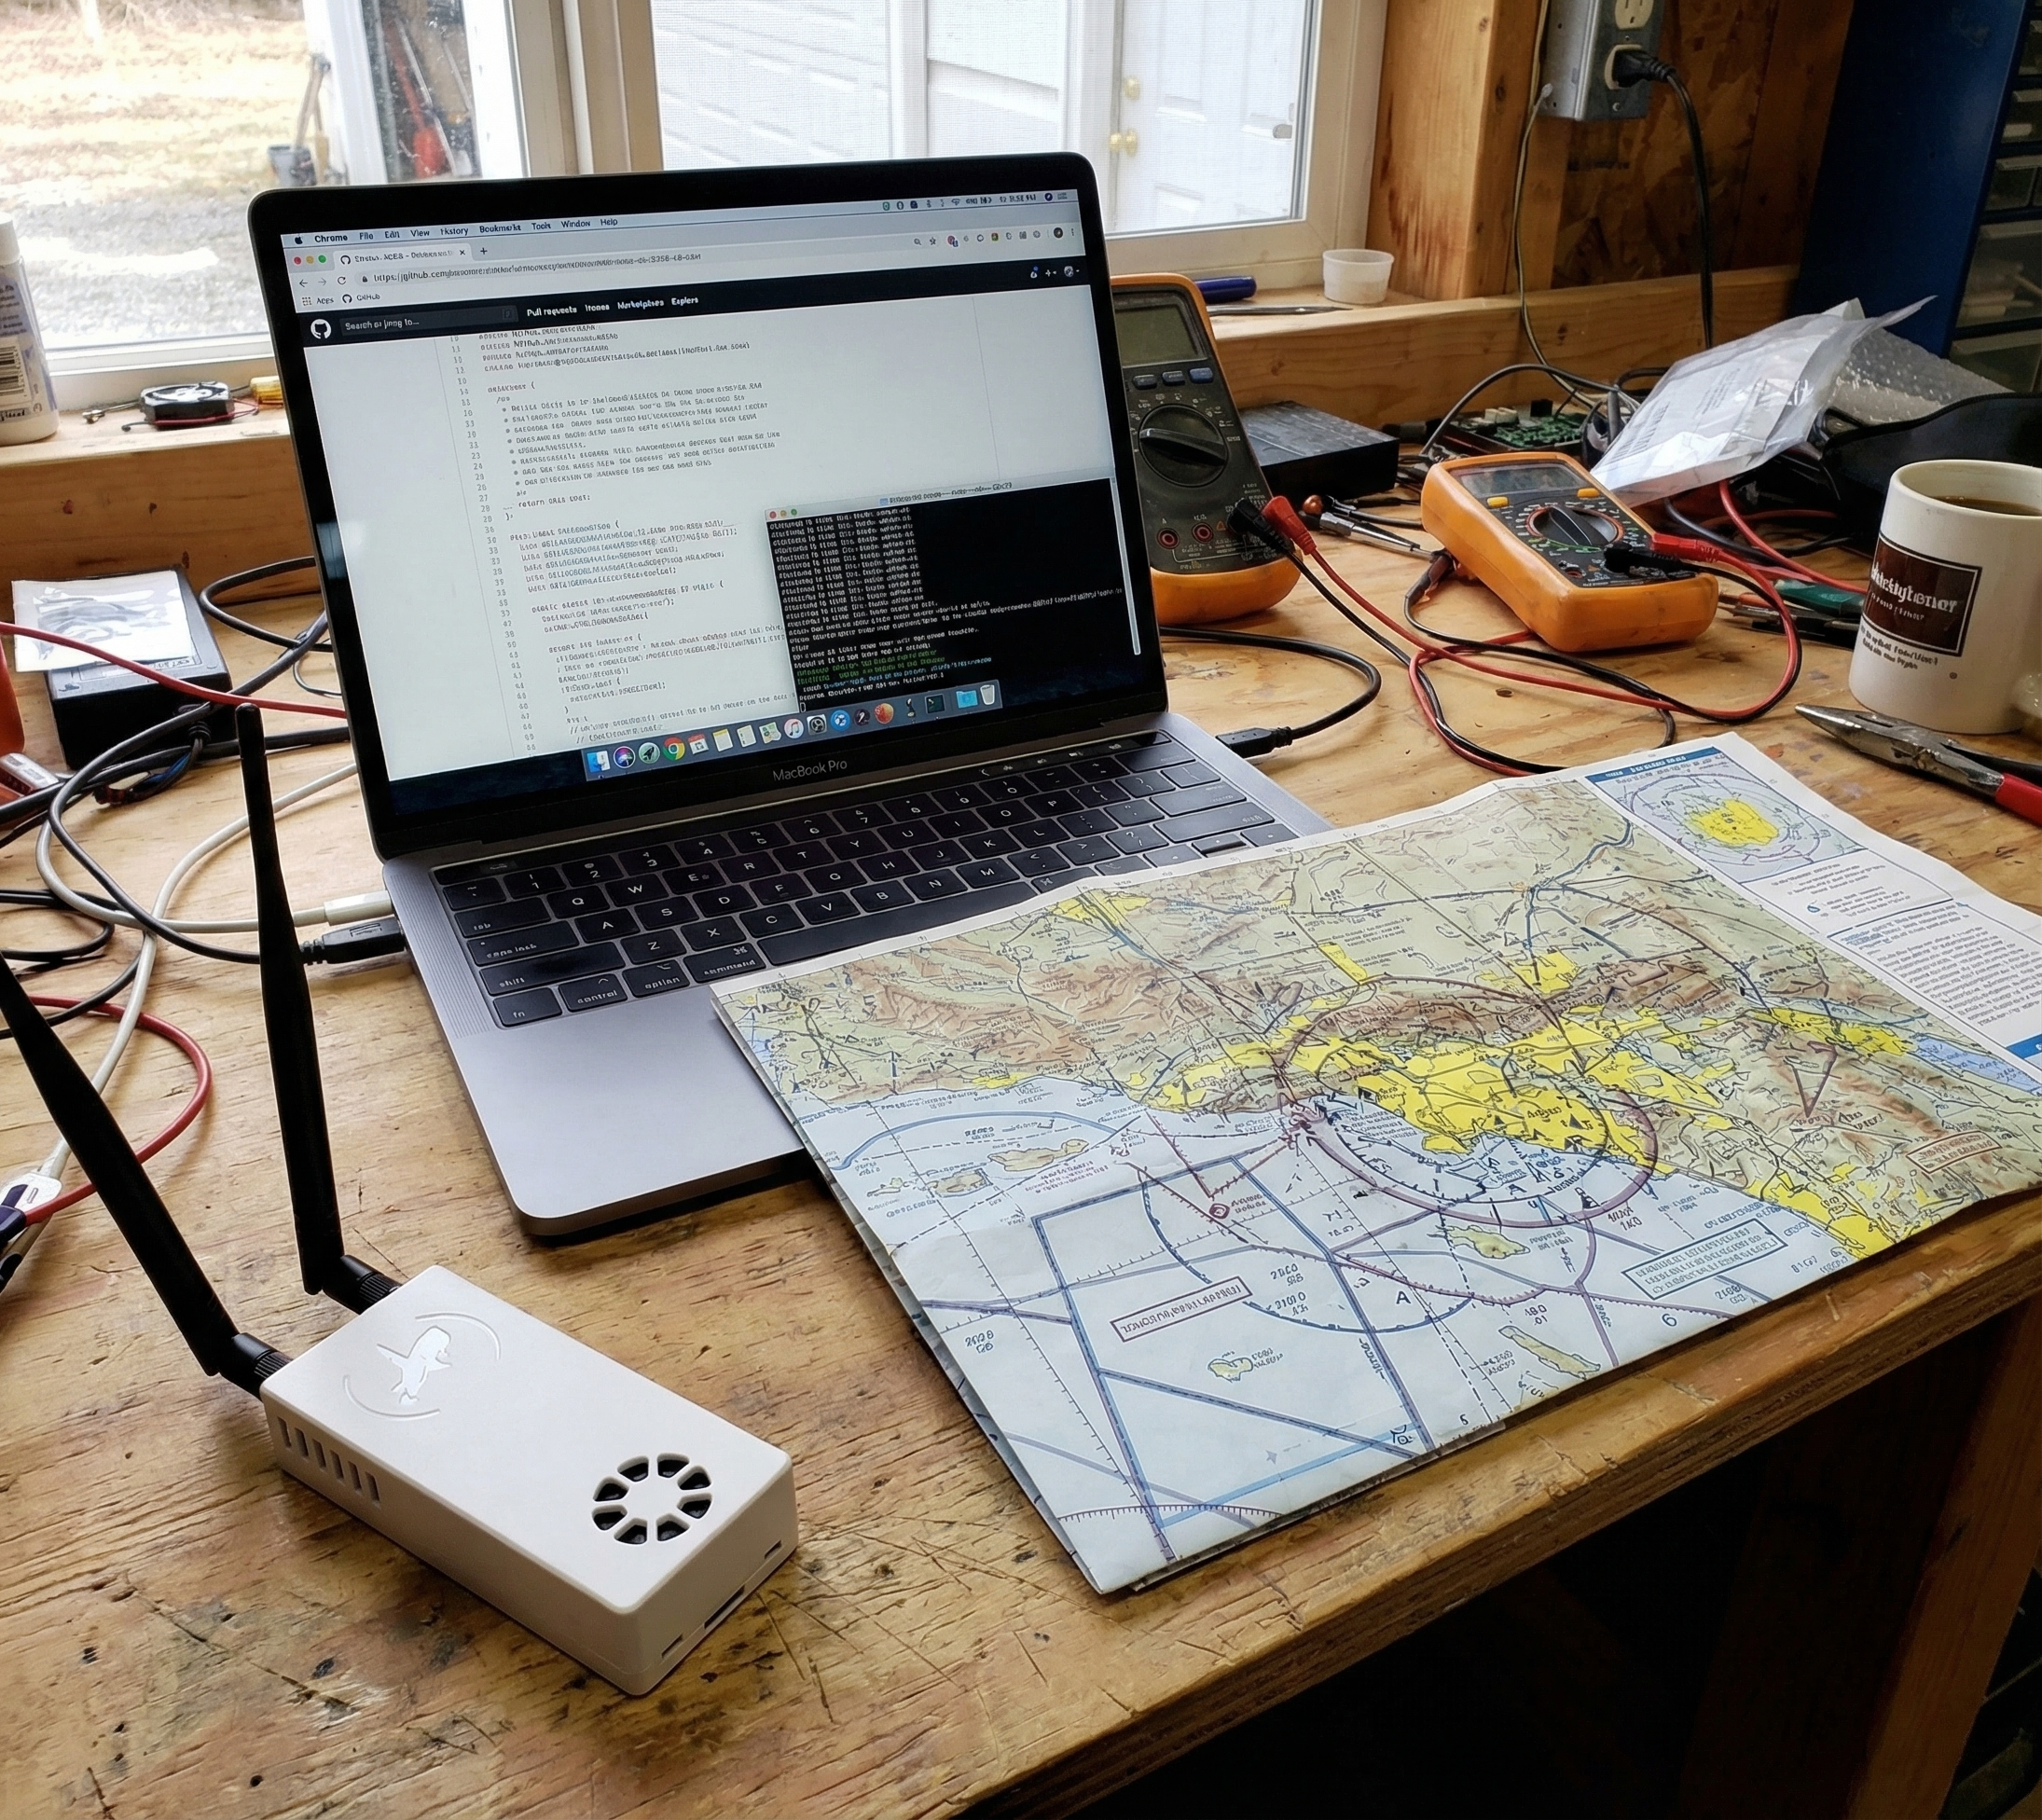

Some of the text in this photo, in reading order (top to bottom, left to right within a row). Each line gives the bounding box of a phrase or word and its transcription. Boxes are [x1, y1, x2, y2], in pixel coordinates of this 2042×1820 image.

[314, 234, 349, 243] Chrome
[600, 217, 618, 227] Help
[527, 308, 542, 316] Pull
[772, 760, 848, 781] MacBook Pro
[983, 839, 996, 848] K
[881, 861, 895, 869] H
[589, 870, 601, 878] 2
[981, 868, 995, 876] M
[688, 873, 698, 882] E
[775, 884, 783, 892] F
[929, 879, 942, 889] N
[628, 884, 642, 894] W
[718, 896, 731, 904] D
[876, 891, 889, 900] B
[572, 897, 585, 905] Q
[821, 903, 832, 911] V
[661, 907, 673, 917] S
[766, 916, 778, 924] C
[602, 921, 614, 930] A
[707, 928, 721, 938] X
[647, 941, 660, 951] Z
[1396, 1290, 1412, 1304] A
[1662, 1312, 1677, 1328] 6
